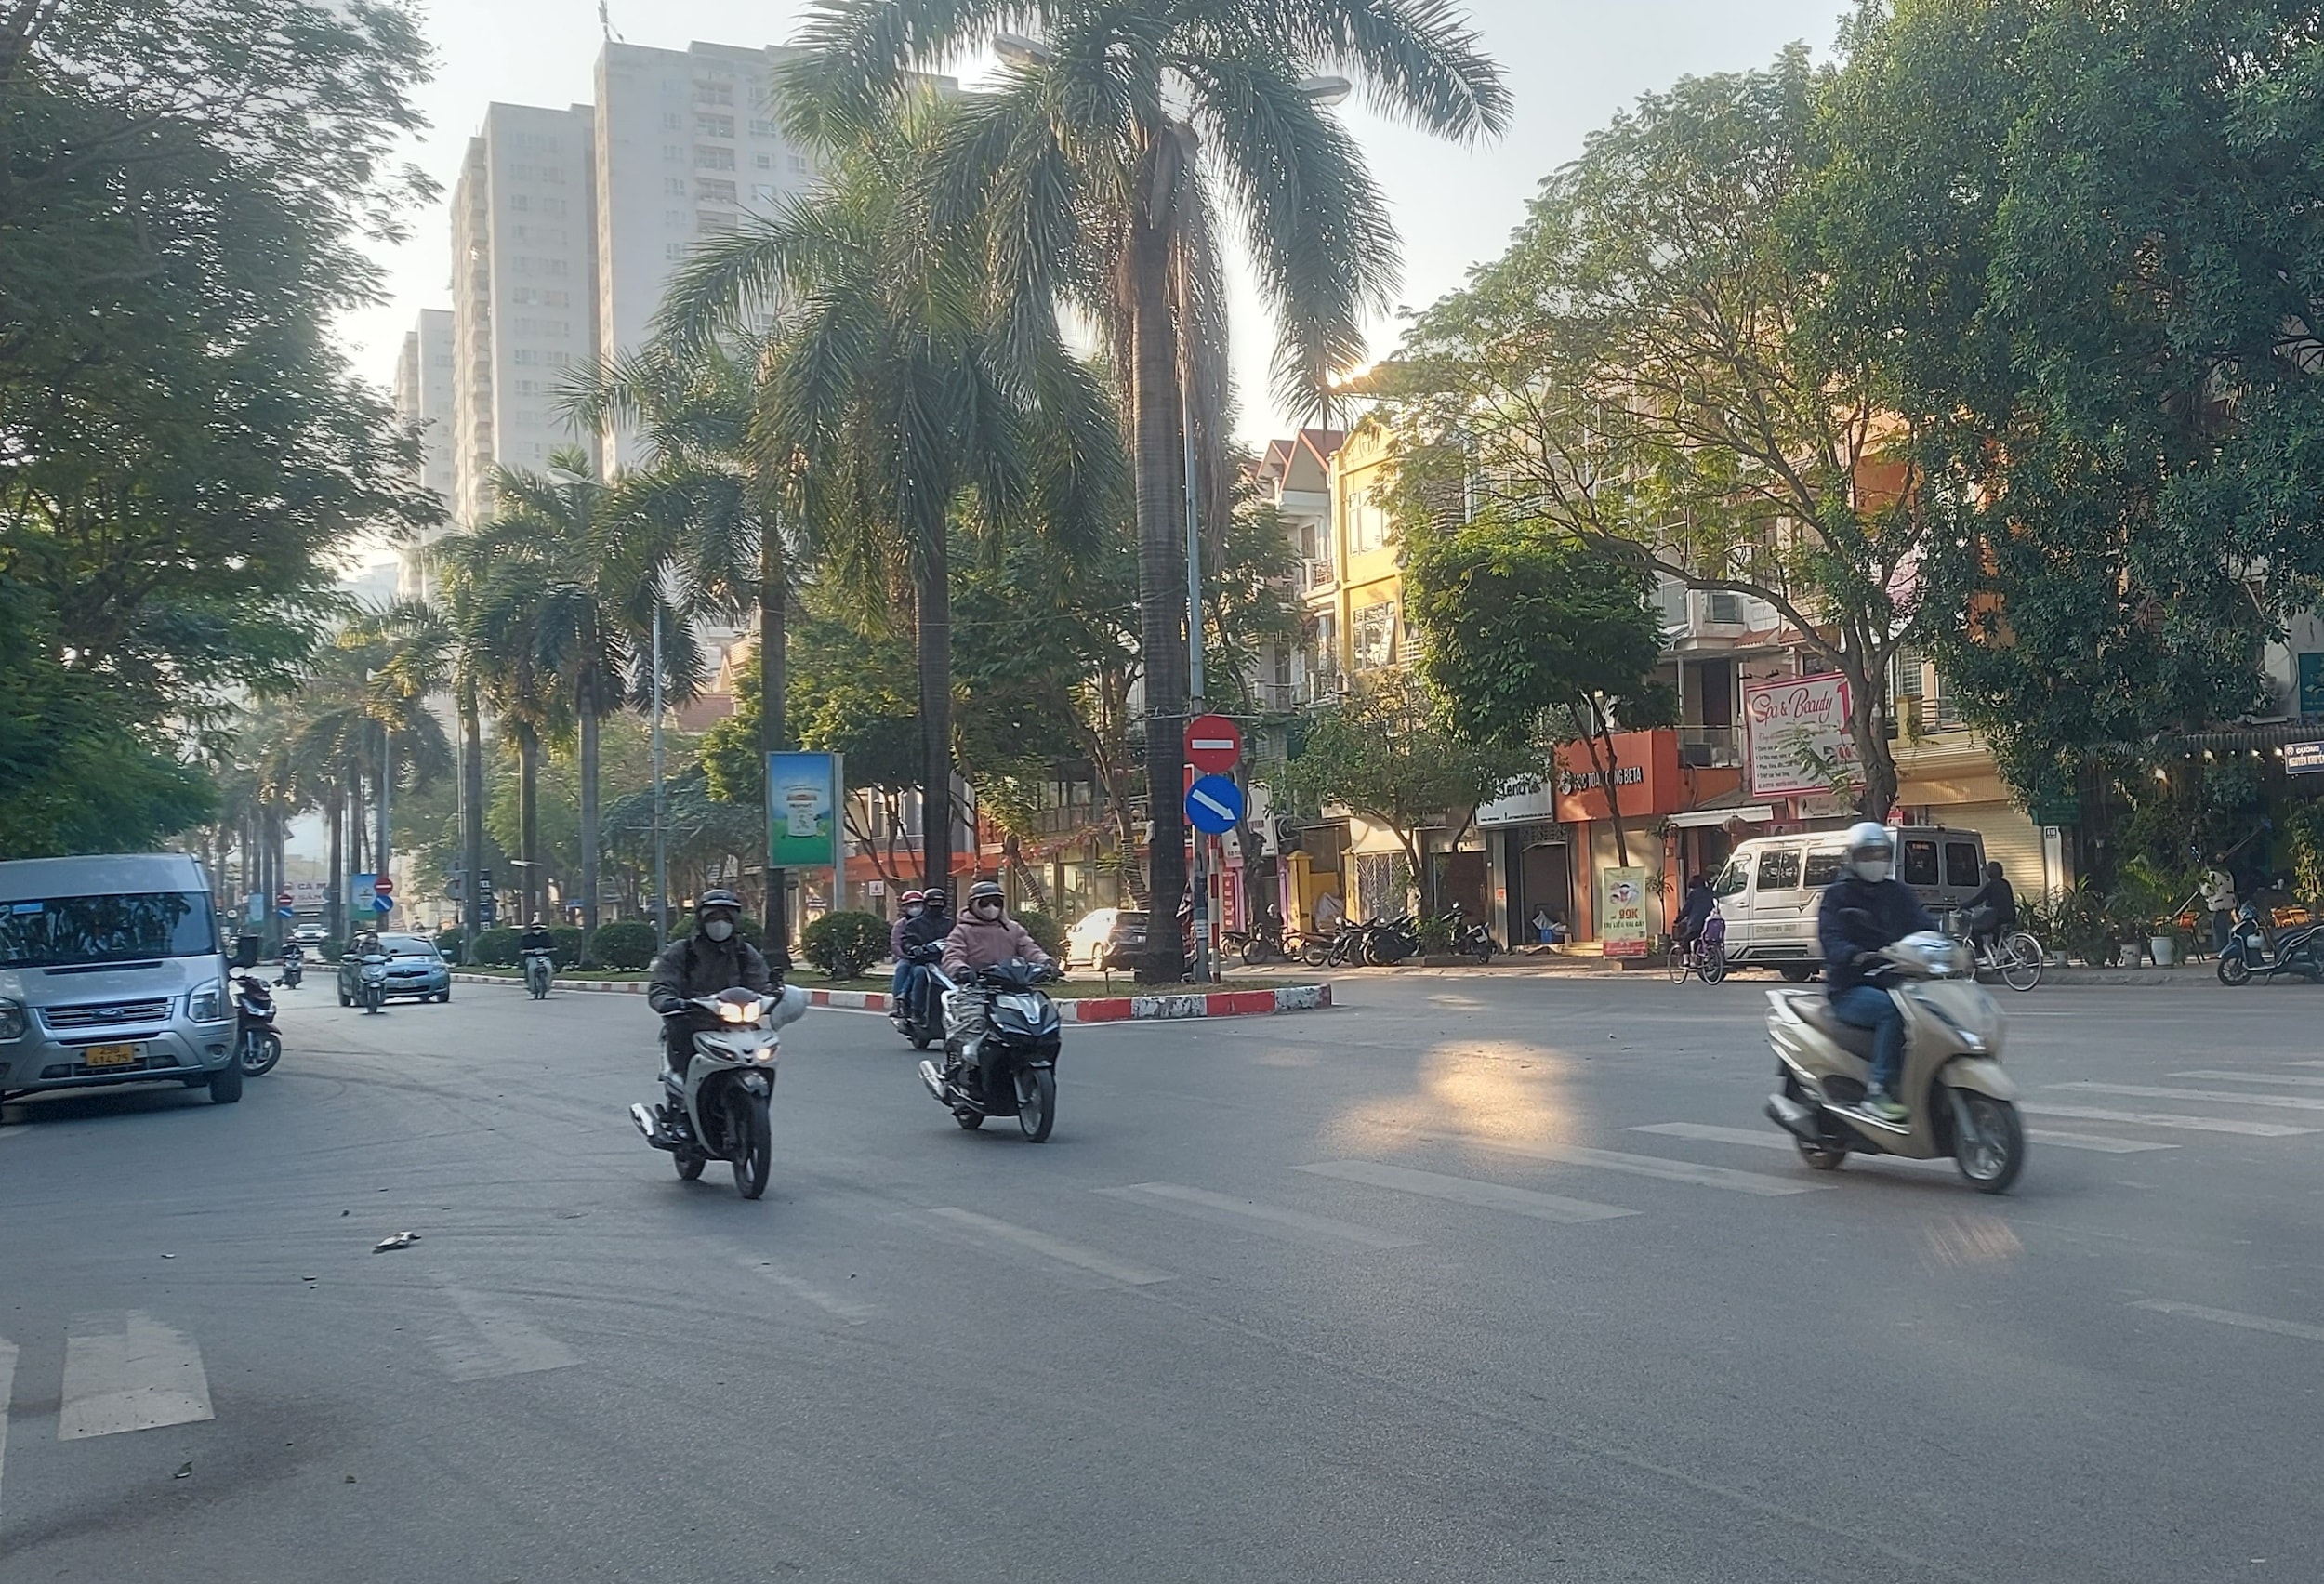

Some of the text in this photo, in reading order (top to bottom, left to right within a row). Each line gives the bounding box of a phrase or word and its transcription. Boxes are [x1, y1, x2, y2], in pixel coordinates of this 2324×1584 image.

[1752, 687, 1832, 726] Spa & Beauty
[1604, 768, 1625, 787] CNG
[1625, 766, 1643, 785] BETA
[1619, 908, 1639, 919] 99K
